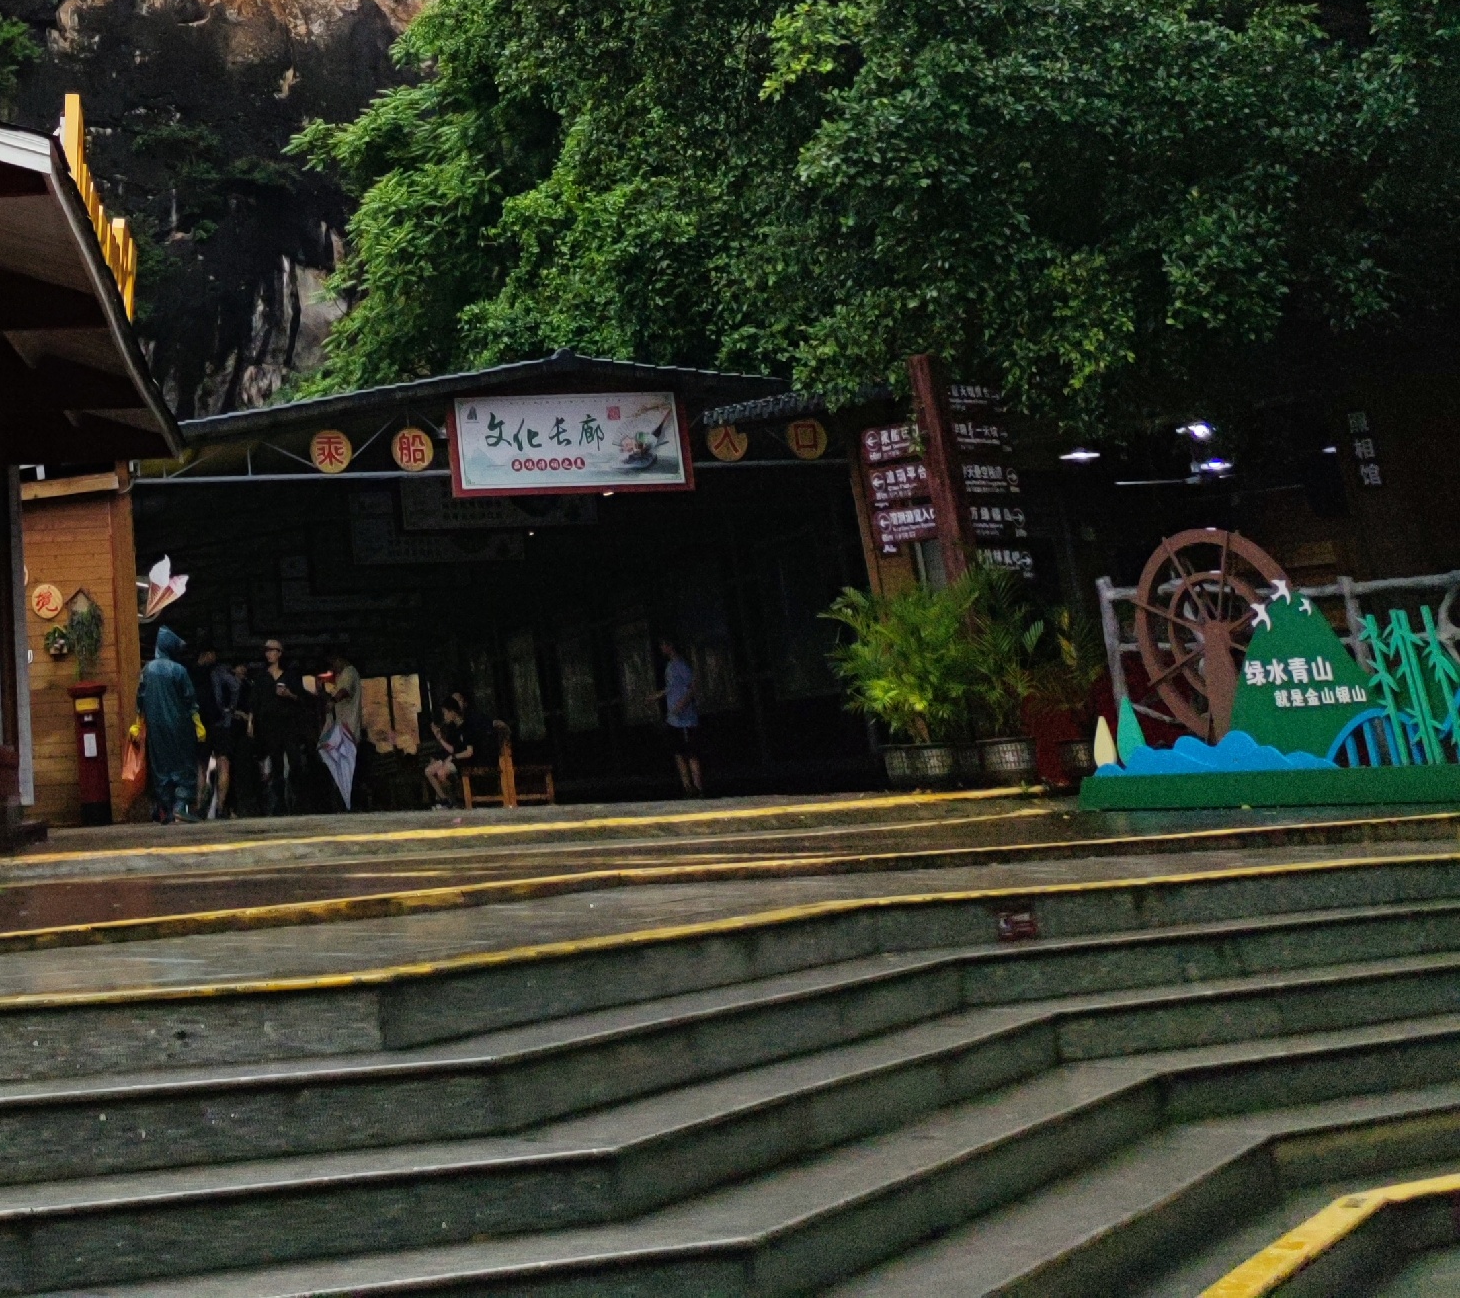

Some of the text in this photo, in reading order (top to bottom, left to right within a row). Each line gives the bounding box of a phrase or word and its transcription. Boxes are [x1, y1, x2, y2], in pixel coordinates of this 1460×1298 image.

[485, 411, 605, 452] 文化长廊
[1243, 655, 1335, 686] 绿水青山
[1273, 684, 1368, 708] 就是金山银山
